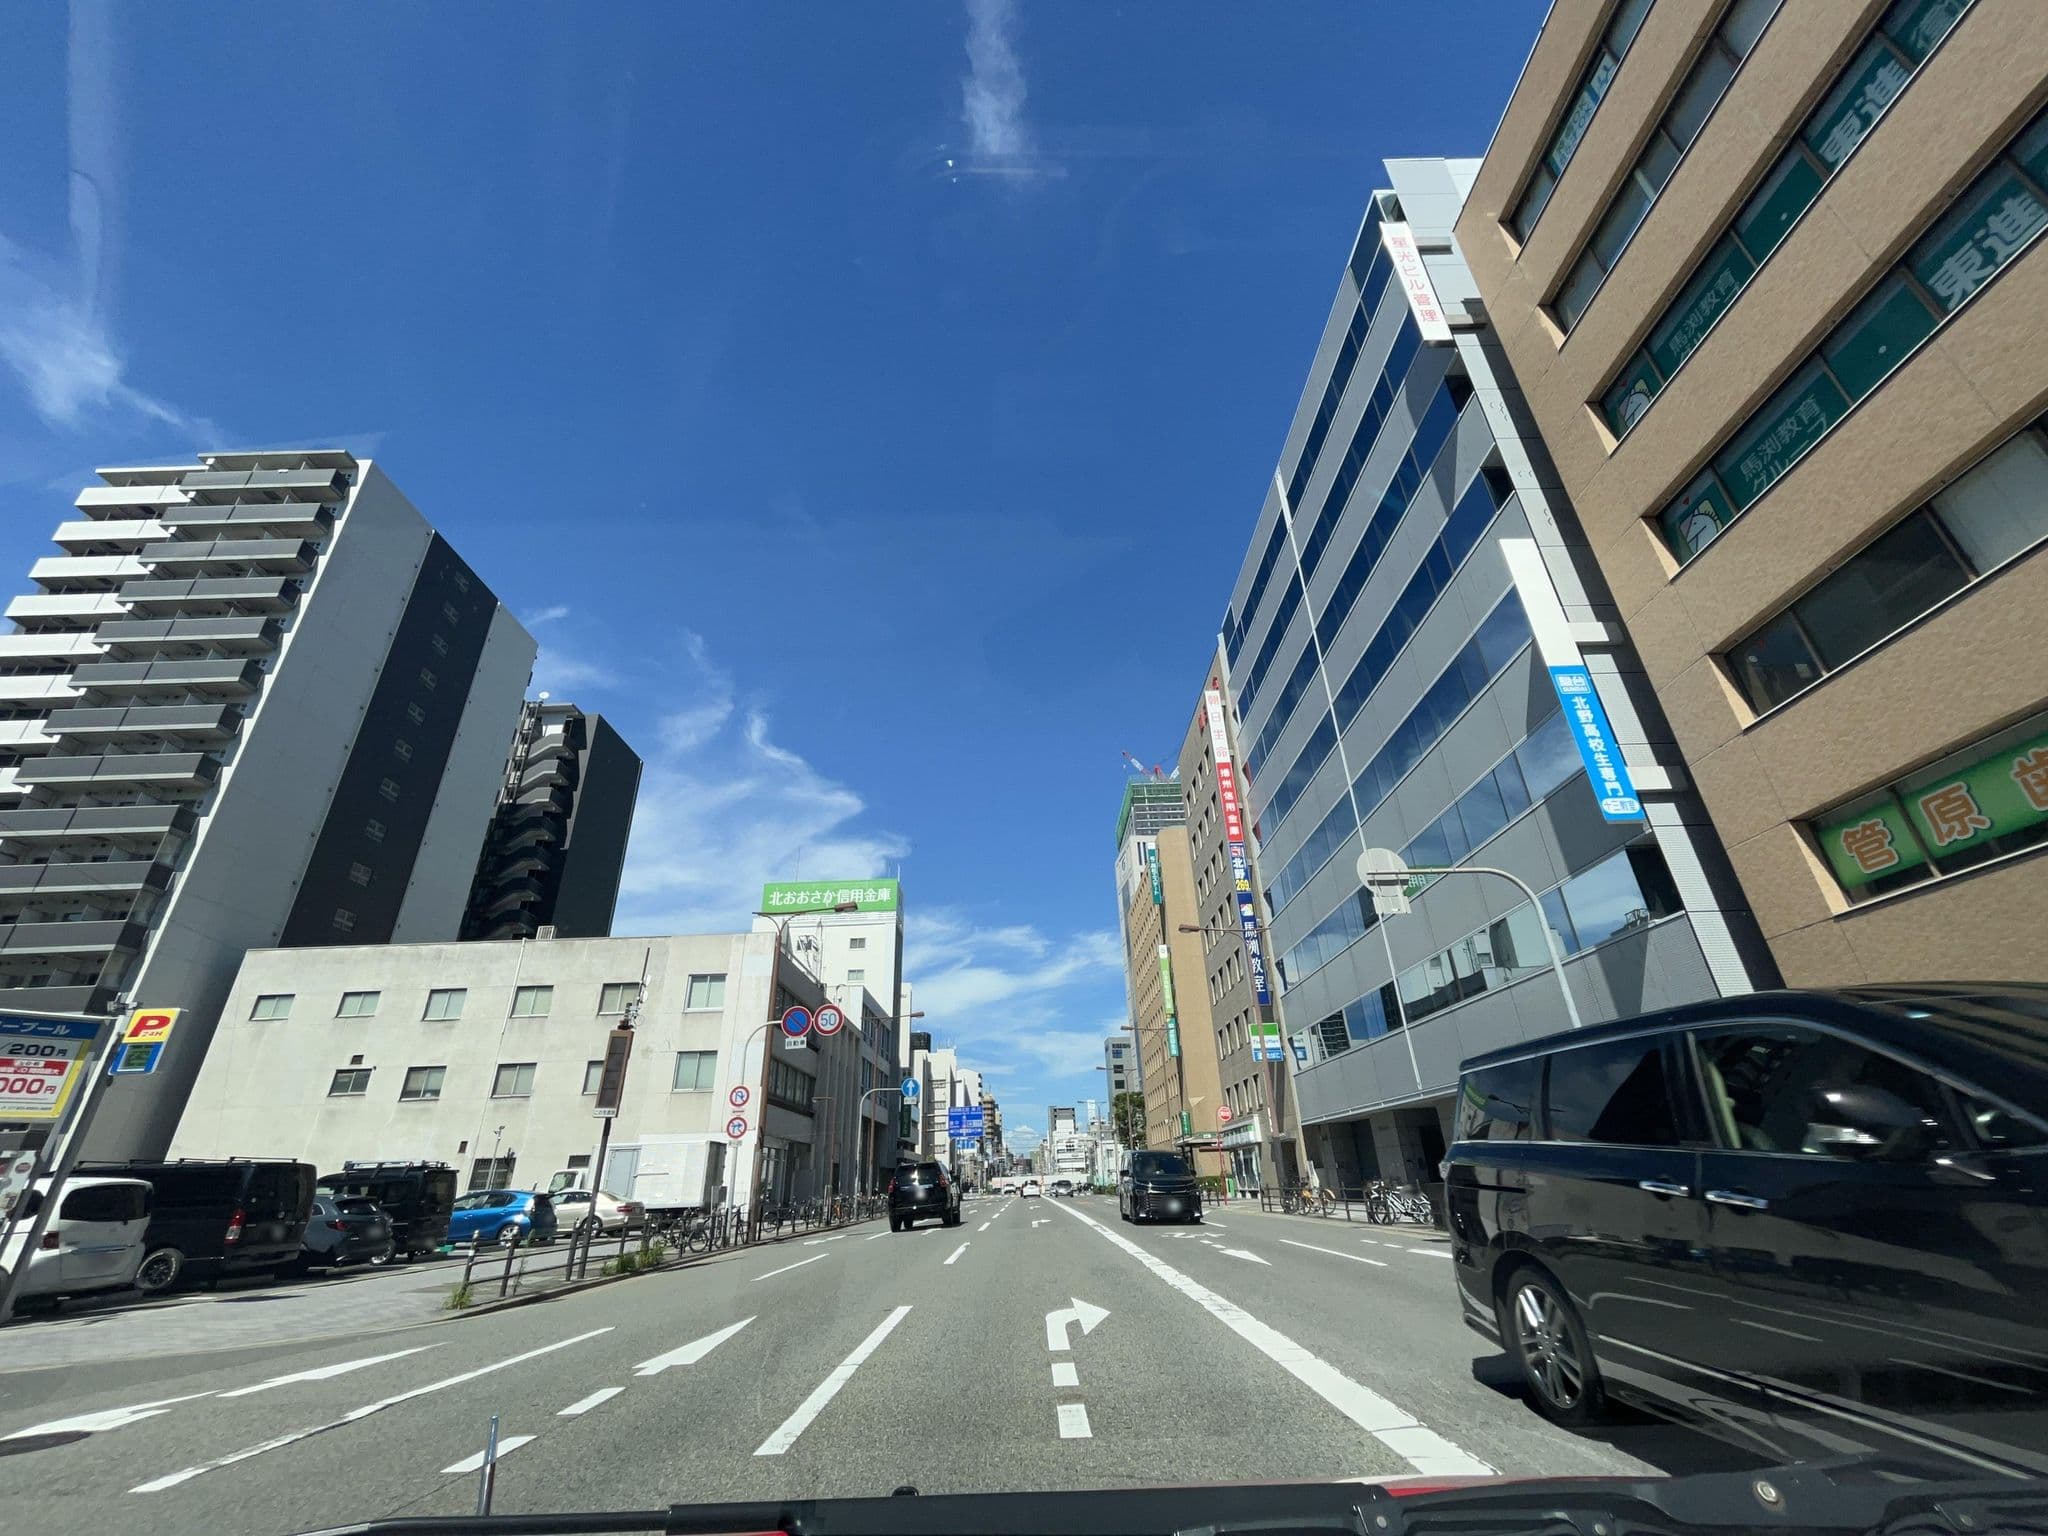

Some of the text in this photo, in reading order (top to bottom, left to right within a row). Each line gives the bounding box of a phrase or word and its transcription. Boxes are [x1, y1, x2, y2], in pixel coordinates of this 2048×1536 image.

[1927, 192, 2048, 309] 東進
[768, 887, 892, 906] 北おおさか信用金庫
[127, 1015, 171, 1038] P
[821, 1013, 837, 1027] 50
